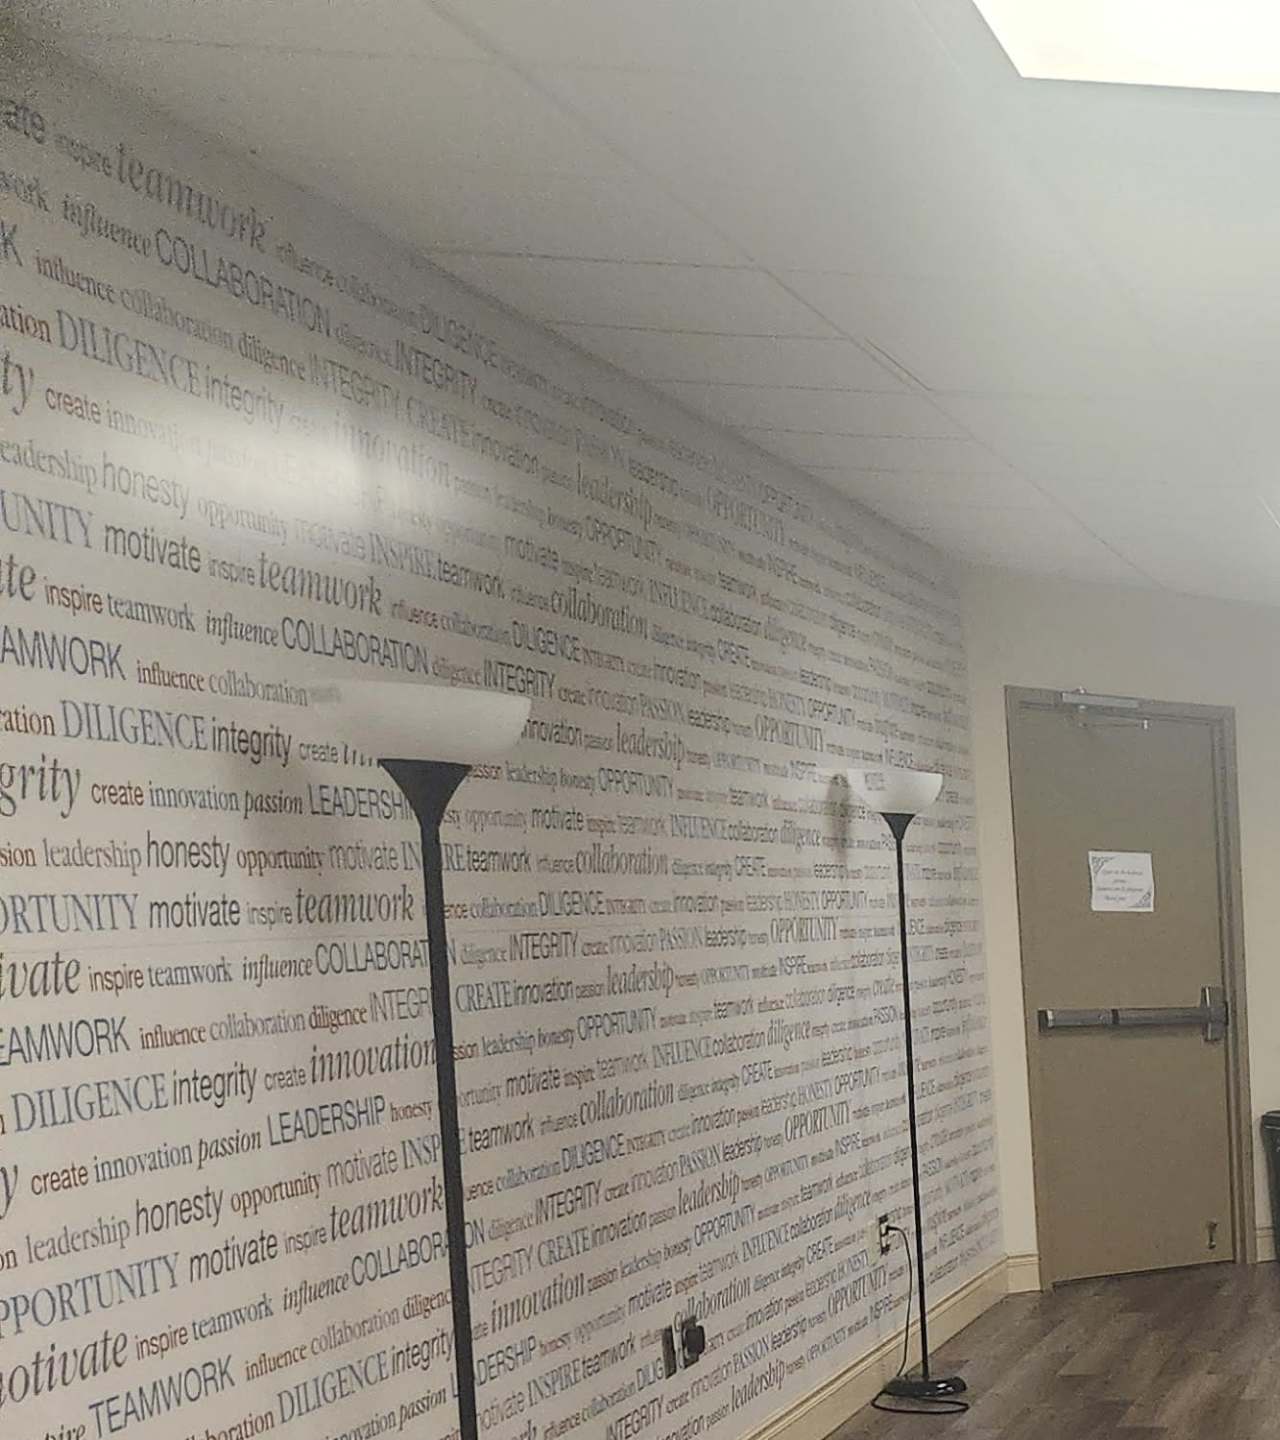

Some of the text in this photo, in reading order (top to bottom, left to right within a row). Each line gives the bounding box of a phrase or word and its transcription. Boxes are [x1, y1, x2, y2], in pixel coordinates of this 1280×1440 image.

[156, 228, 331, 337] COLLABORATION
[45, 385, 101, 424] create
[56, 308, 201, 397] DILIGENCE
[205, 365, 283, 432] integrity
[0, 439, 97, 494] eadership
[102, 455, 190, 519] honesty
[104, 524, 201, 573] motivate
[259, 552, 381, 615] teamwork
[0, 626, 126, 681] AMWORK
[136, 660, 205, 692] influence
[209, 668, 308, 707] collaboration
[43, 576, 104, 617] inspire
[107, 593, 196, 633] teamwork
[206, 609, 279, 647] influence
[282, 616, 429, 676] COLLABORATION
[483, 659, 556, 700] INTEGRITY
[59, 698, 208, 751] DILIGENCE
[211, 715, 292, 767] integrity
[91, 780, 584, 834] create innovation passion motivate
[42, 838, 141, 877] leadership
[147, 830, 230, 877] honesty
[237, 845, 324, 878] opportunity
[467, 848, 531, 873] teamwork
[576, 843, 668, 877] collaboration
[149, 884, 604, 930] motivate inspire teamwork DILIGENCE
[88, 963, 144, 997] inspire
[148, 956, 233, 987] teamwork
[242, 954, 312, 987] influence
[509, 930, 578, 961] INTEGRITY
[140, 1024, 207, 1050] influence
[209, 1009, 306, 1041] collaboration
[308, 1005, 368, 1033] diligence
[455, 981, 511, 1015] CREATE
[11, 1072, 169, 1133] DILIGENCE
[172, 1061, 257, 1108] integrity
[263, 1064, 306, 1091] create
[310, 1033, 438, 1084] innovation
[576, 1006, 656, 1041] OPPORTUNITY
[25, 1216, 131, 1263] leadership
[136, 1185, 223, 1236] honesty
[231, 1172, 321, 1217] opportunity
[327, 1147, 399, 1187] motivate
[469, 1112, 534, 1153] teamwork
[580, 1079, 674, 1126] collaboration
[31, 1166, 88, 1196] create
[94, 1142, 193, 1183] innovation
[197, 1128, 262, 1170] passion
[267, 1095, 386, 1147] LEADERSHIP
[505, 1068, 560, 1099] motivate
[189, 1230, 278, 1282] motivate
[284, 1225, 327, 1255] inspire
[330, 1176, 443, 1241] teamwork
[562, 1133, 624, 1173] DILIGENCE
[0, 1329, 128, 1406] otivate
[135, 1326, 189, 1361] inspire
[192, 1293, 274, 1340] teamwork
[283, 1271, 350, 1314] influence
[536, 1178, 601, 1225] INTEGRITY
[89, 1354, 236, 1439] TEAMWORK
[245, 1343, 306, 1381] influence
[311, 1305, 399, 1356] collaboration
[277, 1350, 388, 1424] DILIGENCE
[392, 1327, 454, 1376] integrity
[582, 1332, 634, 1378] teamwork
[399, 1386, 447, 1431] passion
